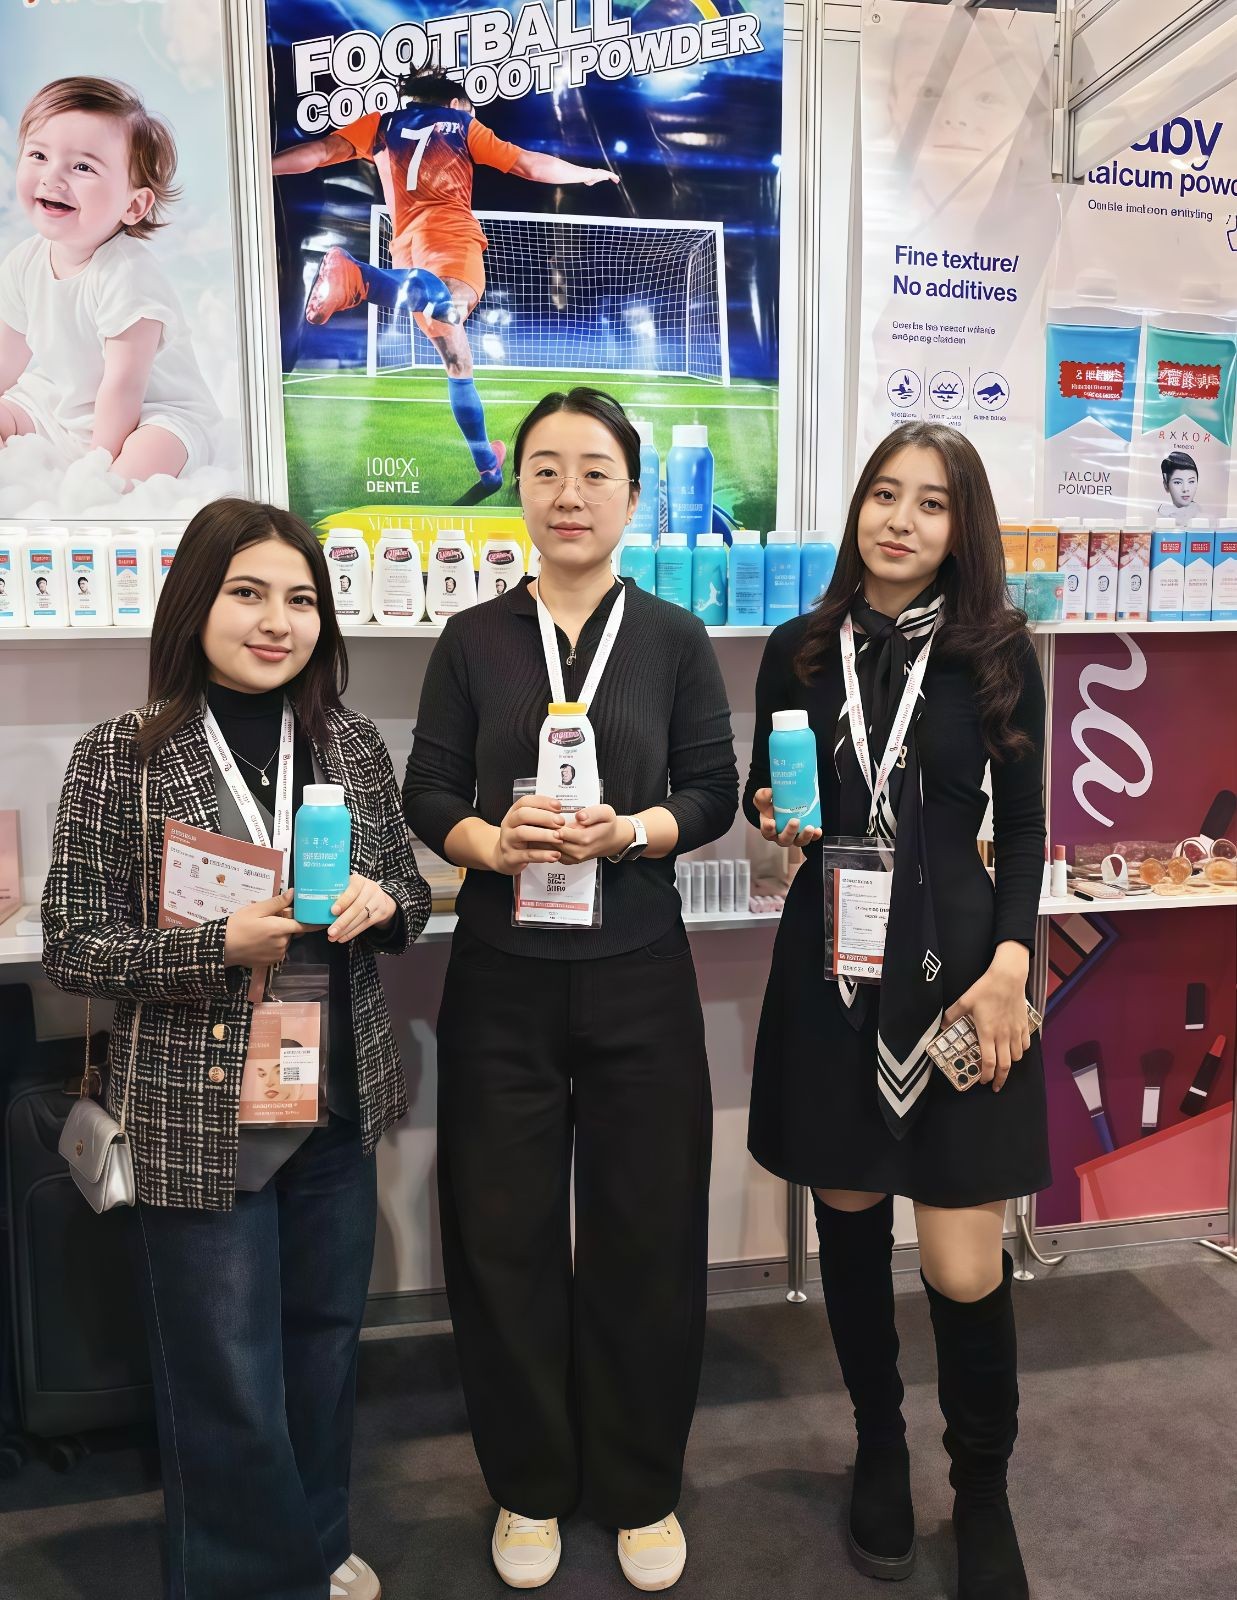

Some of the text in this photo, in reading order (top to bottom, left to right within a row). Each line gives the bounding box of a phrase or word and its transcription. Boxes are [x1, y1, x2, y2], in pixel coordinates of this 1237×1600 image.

[292, 0, 632, 95] FOOTBALL
[296, 78, 413, 134] COO
[569, 13, 764, 88] POWDER
[401, 124, 436, 191] 7
[895, 244, 1019, 272] Fine texture/
[893, 274, 1018, 302] No additives
[1058, 483, 1112, 496] POWDER
